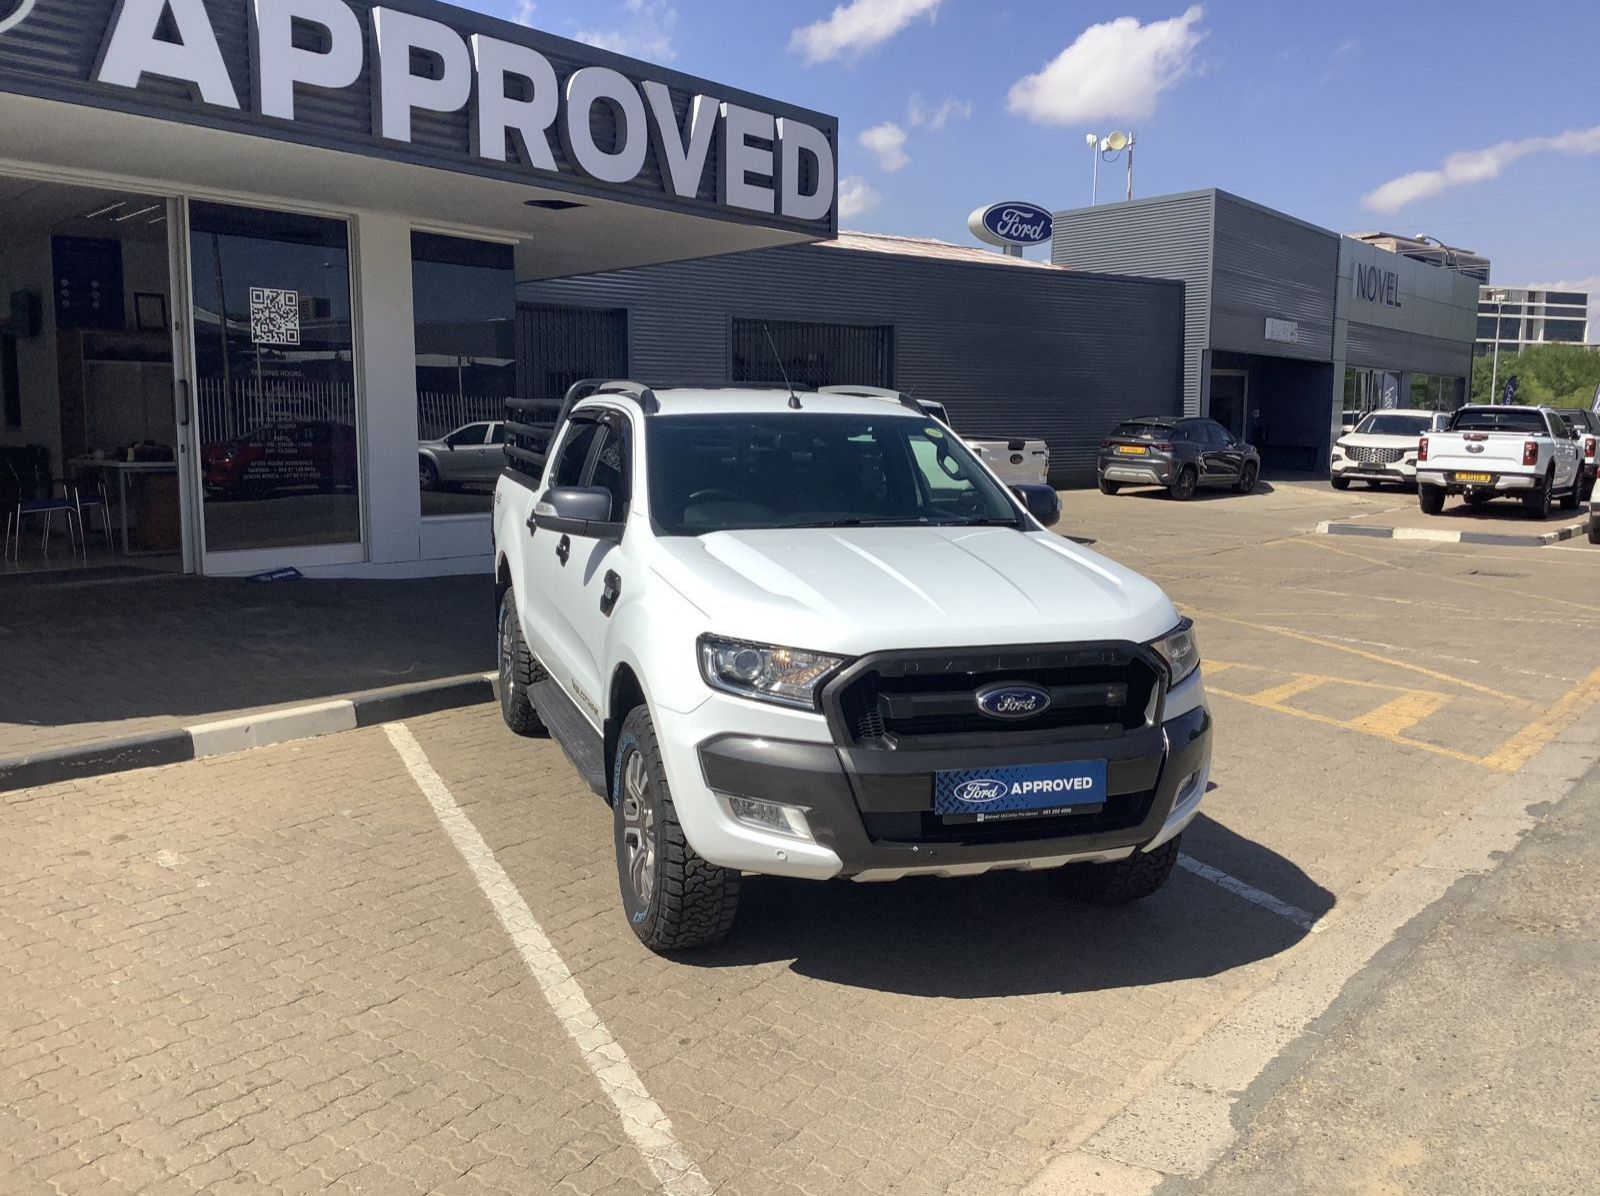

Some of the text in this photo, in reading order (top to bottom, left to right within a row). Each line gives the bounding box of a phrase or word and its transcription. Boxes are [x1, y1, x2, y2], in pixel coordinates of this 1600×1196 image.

[95, 0, 835, 220] APPROVED
[997, 209, 1045, 239] Ford
[1357, 262, 1402, 308] NOVEL
[996, 693, 1037, 712] Ford
[963, 776, 1093, 800] Ford APPROVED
